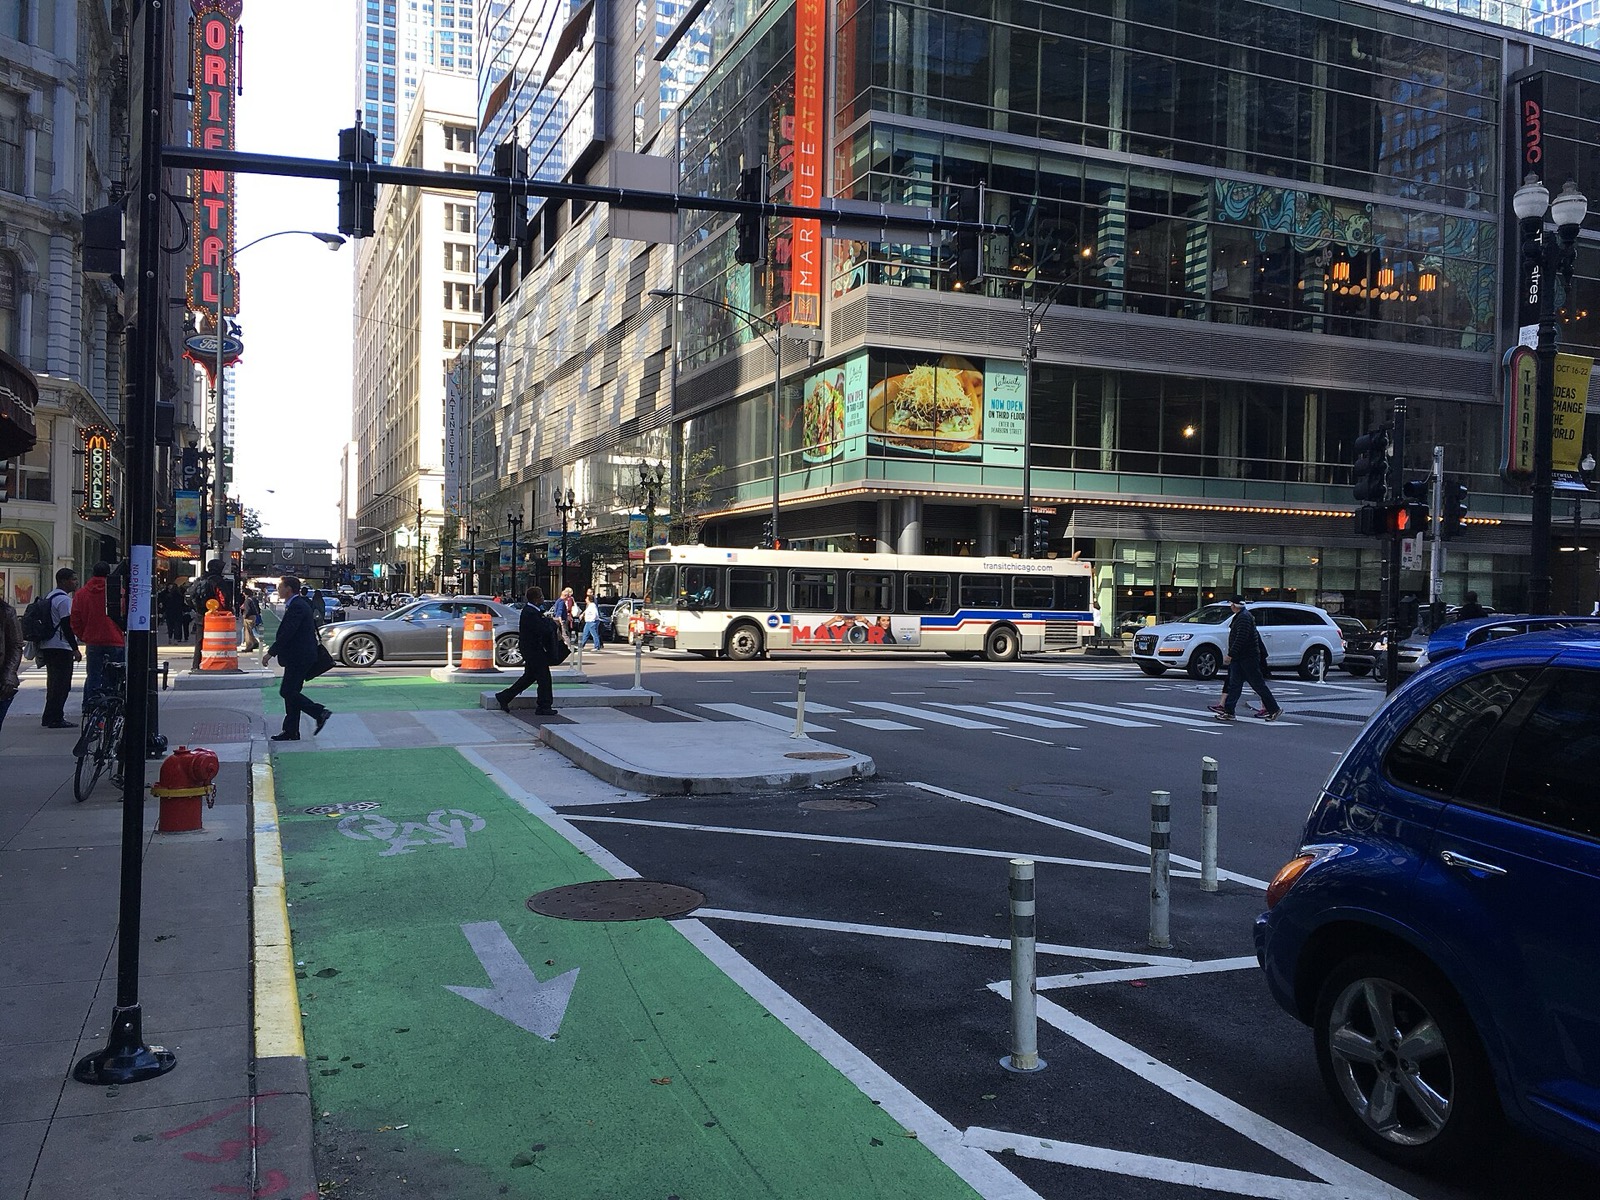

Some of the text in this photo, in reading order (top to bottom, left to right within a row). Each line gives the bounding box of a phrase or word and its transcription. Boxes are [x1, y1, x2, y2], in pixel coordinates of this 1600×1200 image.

[800, 0, 817, 287] MARUEE AT BLOCK 3
[1525, 100, 1542, 164] amc
[203, 20, 226, 303] ORIENTAL
[1556, 364, 1588, 376] OCT 16-22
[448, 389, 457, 469] LATINICITY
[988, 410, 1025, 421] ON THIRD FLOOR
[991, 399, 1023, 411] NOW OPEN
[1520, 369, 1532, 467] THEATRE
[1552, 427, 1575, 441] ORLD
[131, 563, 139, 613] NO PARKING
[983, 562, 1053, 572] transitchicago.com
